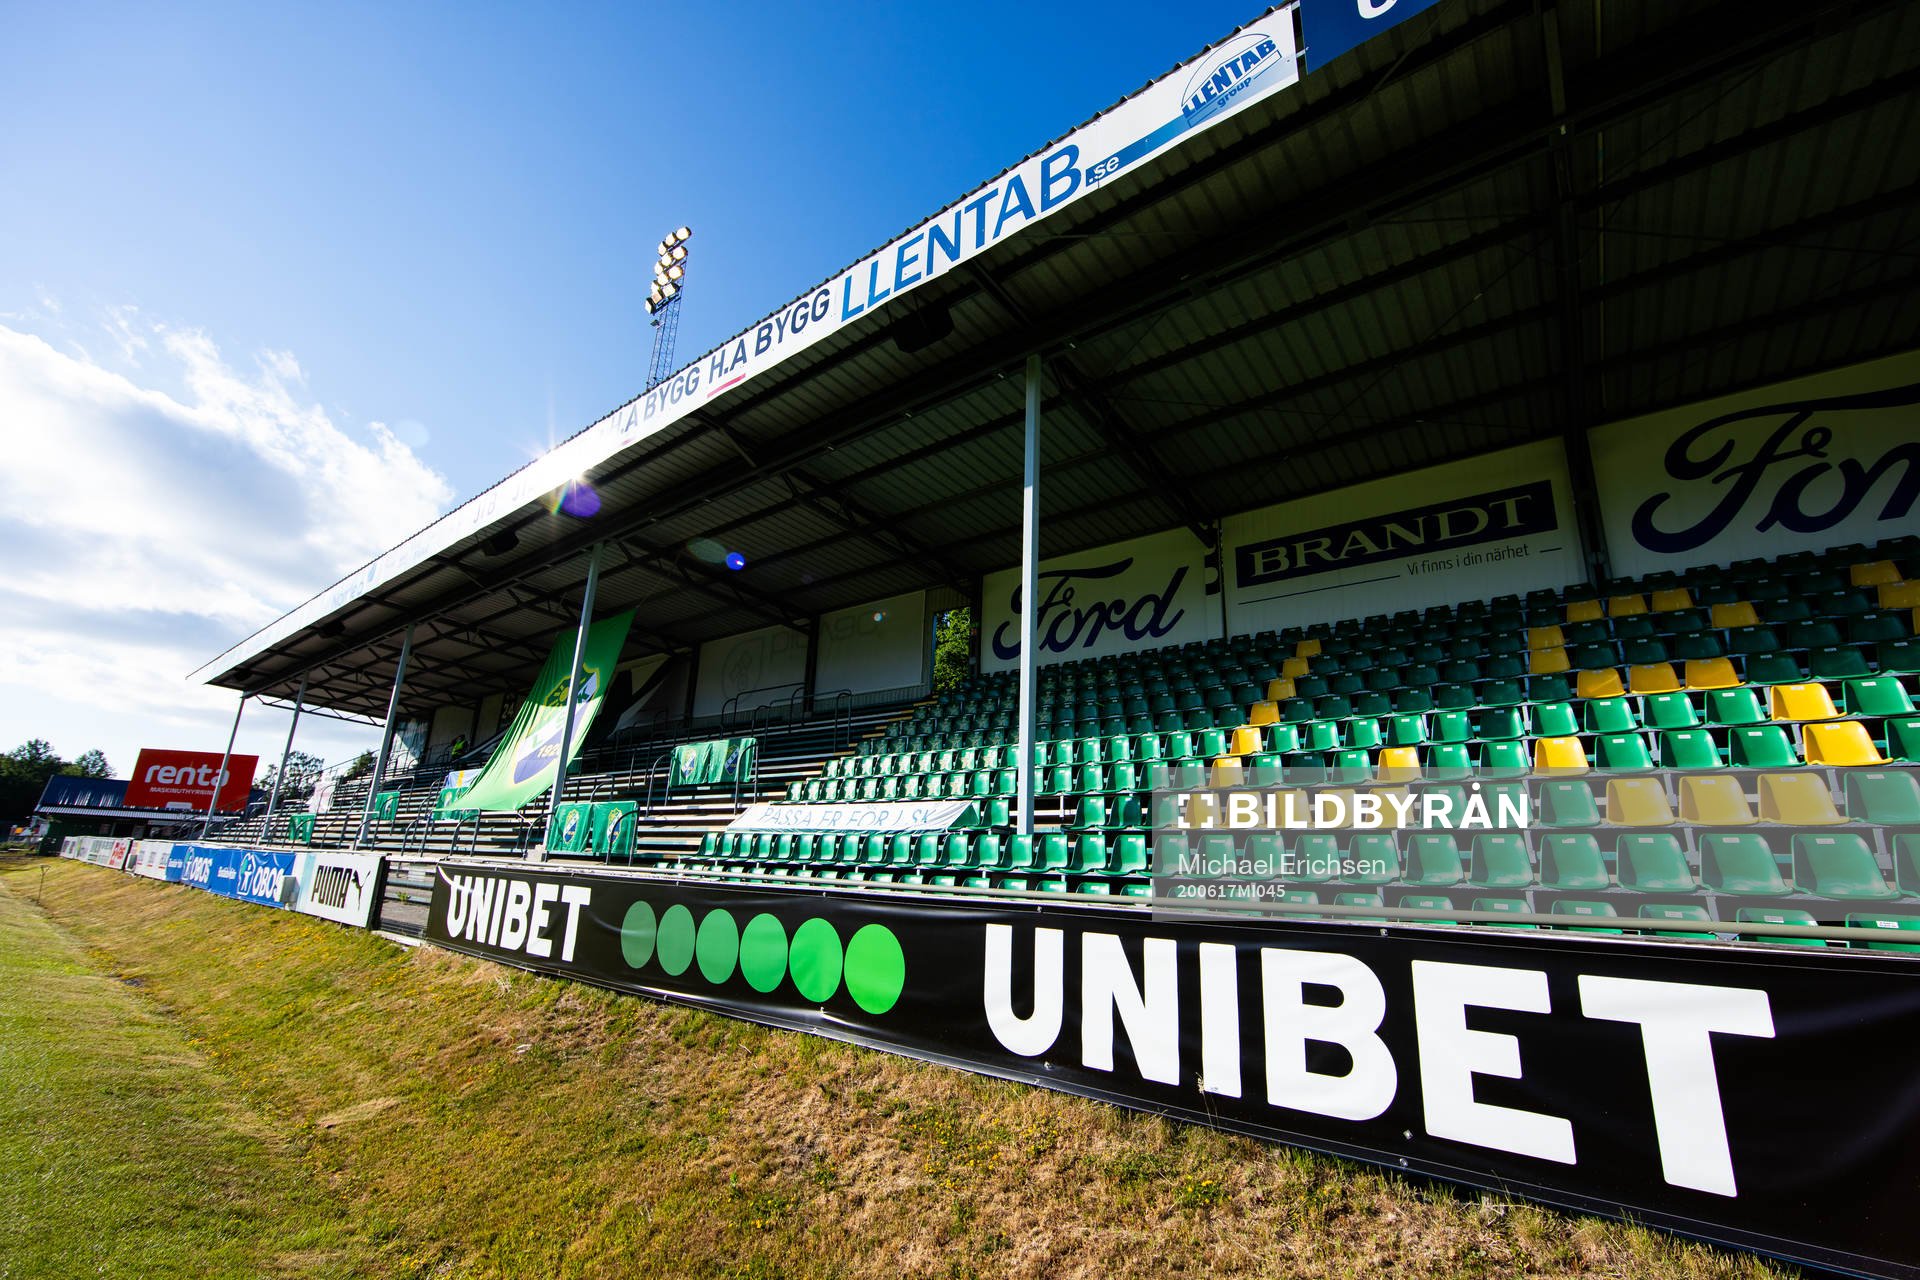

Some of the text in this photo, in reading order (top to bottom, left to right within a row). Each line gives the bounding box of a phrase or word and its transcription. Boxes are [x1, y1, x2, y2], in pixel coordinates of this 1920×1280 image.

[1182, 38, 1276, 121] LLENTAB
[1216, 76, 1252, 109] group
[840, 143, 1081, 322] LLENTAB
[708, 287, 831, 387] H.A BYGG
[643, 366, 701, 421] BYGG
[1249, 494, 1533, 577] BRANDT
[1407, 561, 1418, 576] Vi
[1421, 557, 1453, 574] finns
[1463, 551, 1483, 567] din
[1486, 543, 1530, 562] närhet
[992, 557, 1190, 660] Ford
[144, 763, 230, 787] renta
[758, 806, 812, 826] PASSA
[252, 865, 285, 902] OBOS
[311, 865, 353, 909] PUMA
[446, 874, 592, 962] UNIBET
[983, 922, 1776, 1198] UNIBET
